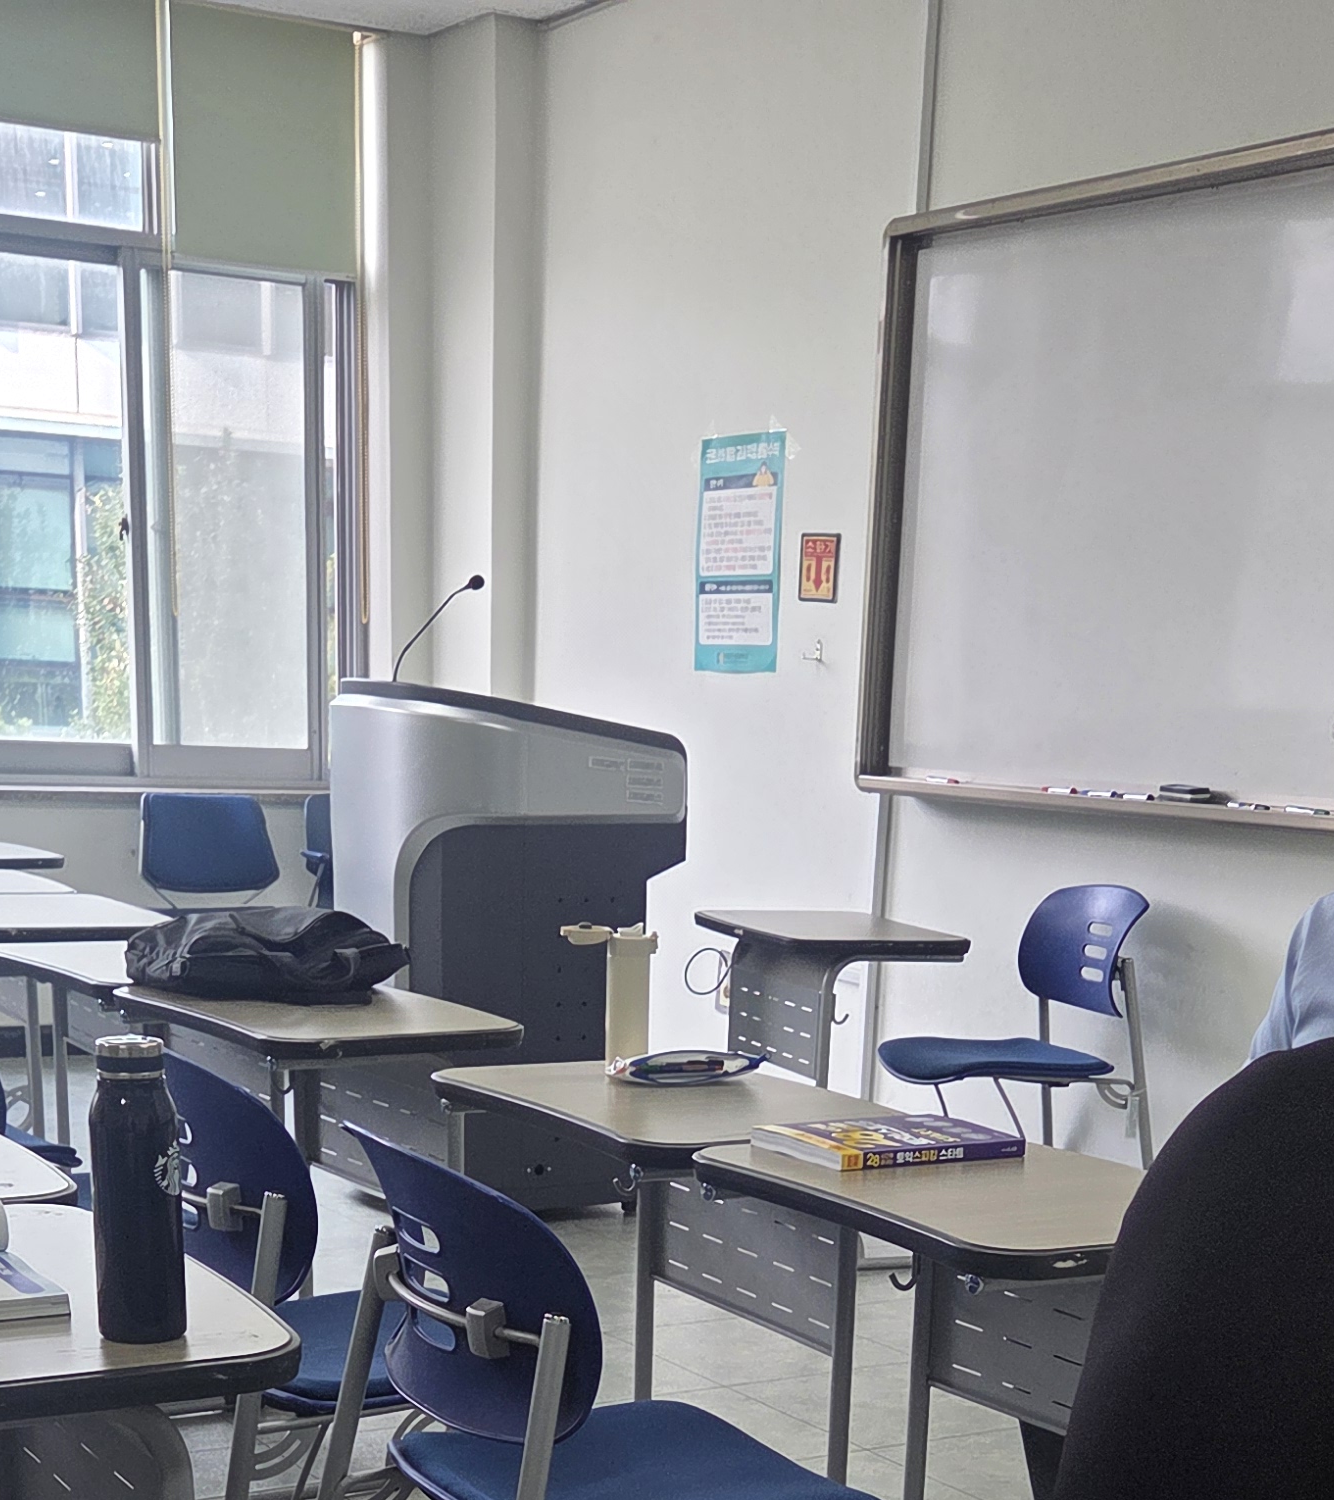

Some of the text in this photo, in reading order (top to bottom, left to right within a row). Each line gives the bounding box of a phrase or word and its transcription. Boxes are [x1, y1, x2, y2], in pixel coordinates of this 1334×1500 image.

[806, 540, 834, 553] 소화기
[866, 1152, 880, 1167] 28
[896, 1151, 938, 1164] 토익스피킹
[939, 1147, 964, 1160] 스타트
